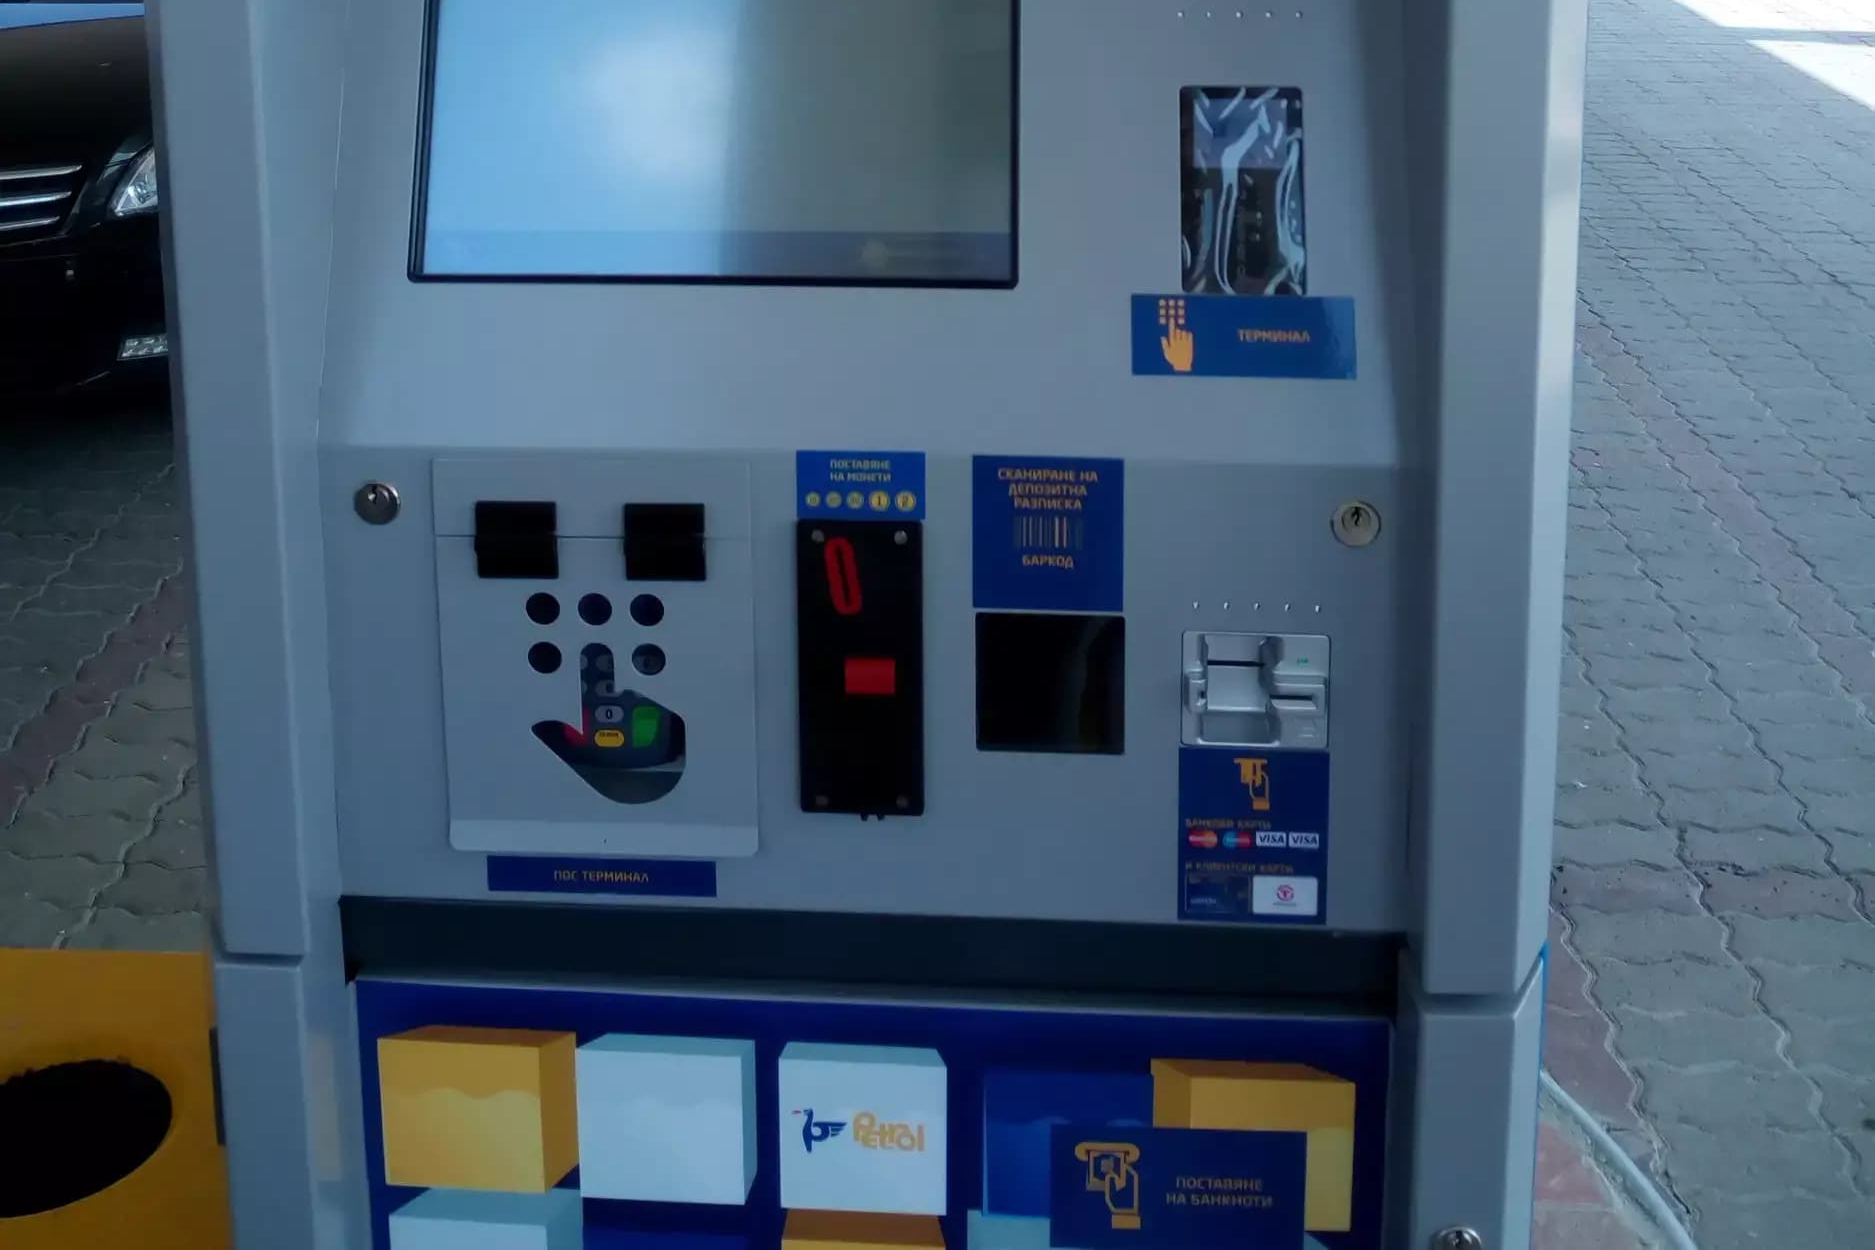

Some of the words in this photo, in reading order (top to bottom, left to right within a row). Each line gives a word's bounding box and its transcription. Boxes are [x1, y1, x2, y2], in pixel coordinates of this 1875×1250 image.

[1238, 329, 1310, 343] ТЕРМИНАЛ
[830, 472, 845, 481] НА
[998, 468, 1075, 482] СКАНИРАНЕ
[1080, 470, 1098, 482] НА
[1008, 483, 1088, 496] ДЕПОЗИТНА
[1014, 497, 1082, 509] РАЗПИСКА
[1022, 554, 1074, 569] БАРКОД
[1259, 834, 1284, 844] VISA
[1292, 835, 1318, 845] VISA
[554, 870, 577, 881] ПОС
[582, 870, 648, 883] ТЕРМИНАЛ
[1176, 1176, 1263, 1191] ПОСТАВЯНЕ
[1166, 1192, 1186, 1205] НА
[1191, 1194, 1272, 1207] БАНКНОТИ
